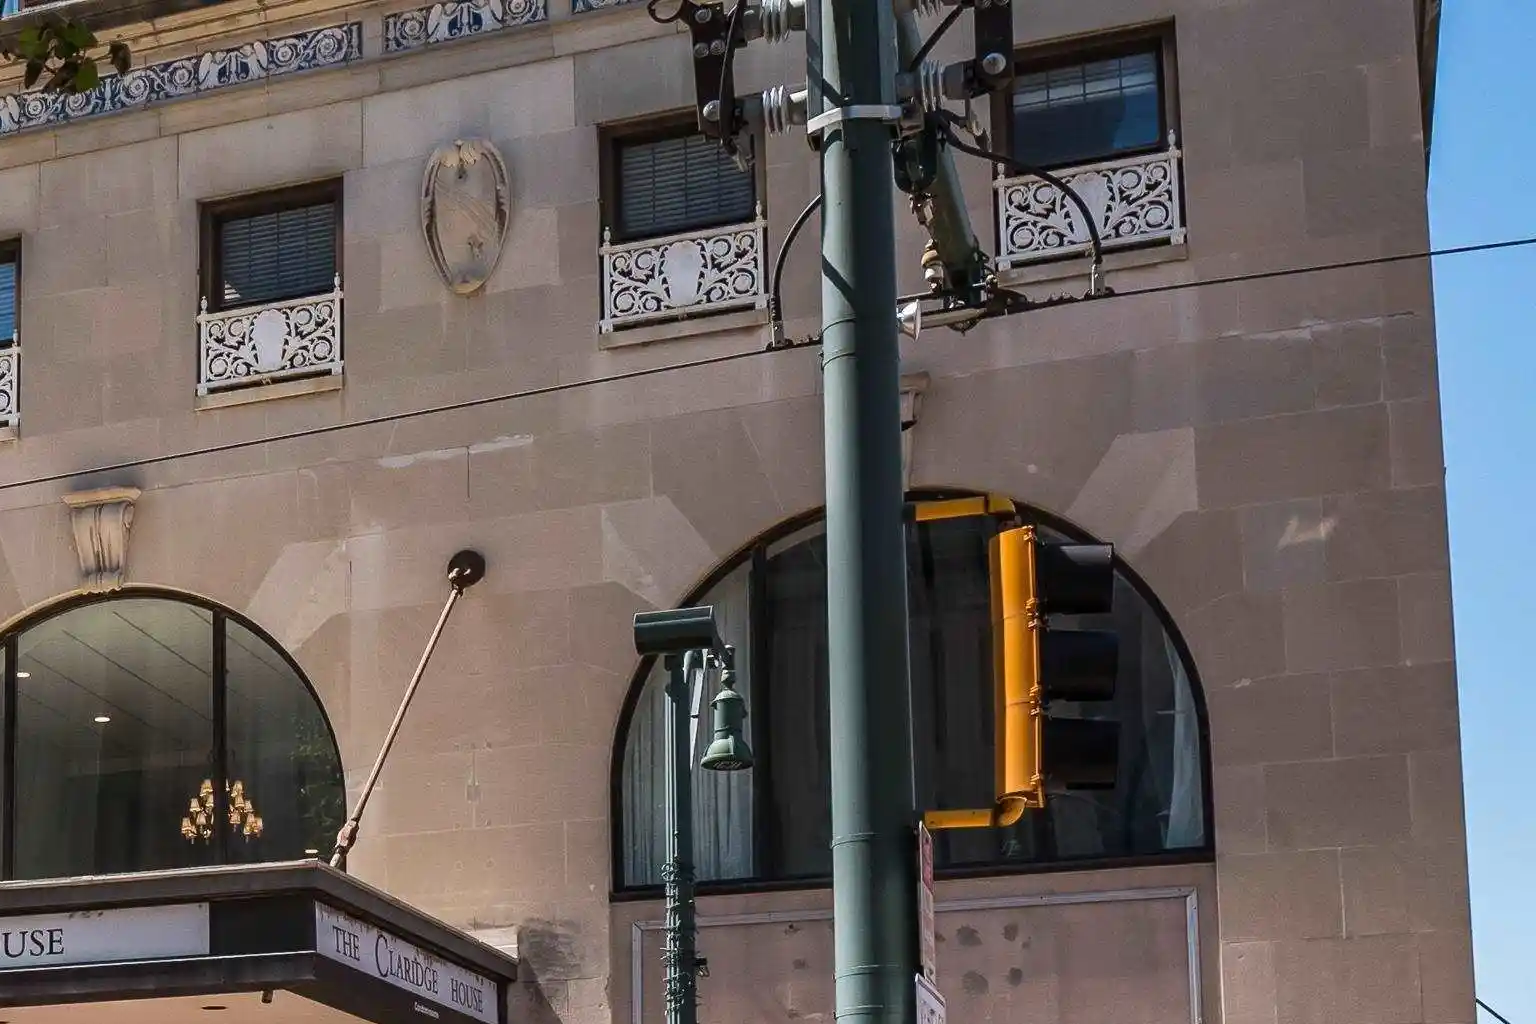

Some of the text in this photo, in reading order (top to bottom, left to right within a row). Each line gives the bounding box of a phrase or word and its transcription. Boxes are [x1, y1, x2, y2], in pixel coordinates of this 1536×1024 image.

[332, 925, 361, 961] THE
[374, 934, 439, 995] CLARIDGE
[451, 978, 484, 1012] HOUSE
